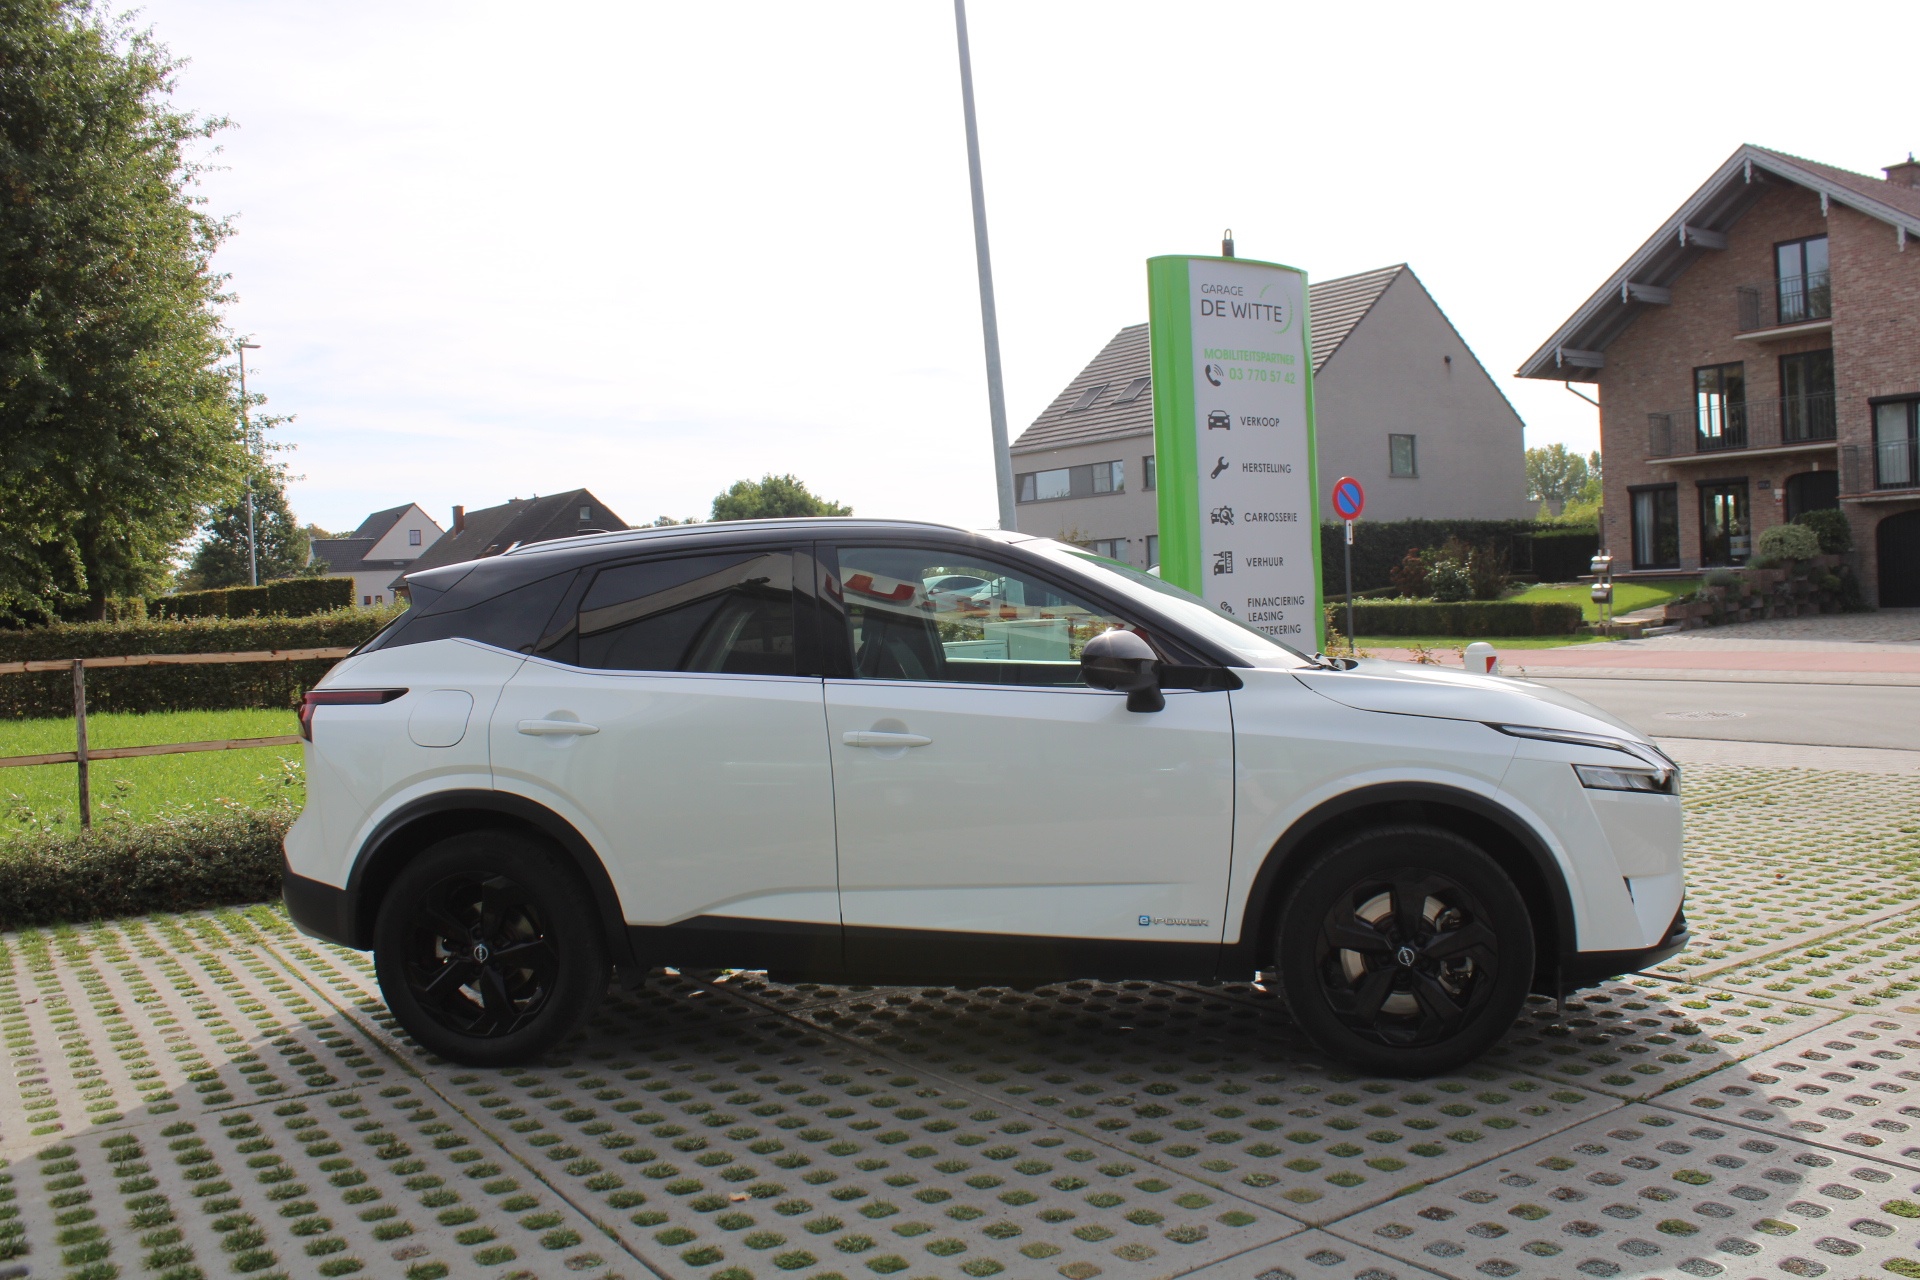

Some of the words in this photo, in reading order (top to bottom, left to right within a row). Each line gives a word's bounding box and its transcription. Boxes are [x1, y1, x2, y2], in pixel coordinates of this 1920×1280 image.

[1201, 283, 1244, 296] GARAGE
[1201, 299, 1226, 317] DE
[1231, 301, 1283, 323] WITTE
[1204, 348, 1295, 365] MOBILITEITSPARTNER
[1229, 368, 1244, 380] 03
[1248, 368, 1267, 382] 770
[1270, 371, 1281, 383] 57
[1284, 372, 1296, 385] 42
[1240, 416, 1280, 427] VERKOOP
[1242, 463, 1292, 474] HERSTELLING
[1244, 512, 1298, 523] CARROSSERIE
[1246, 557, 1284, 567] VERHUUR
[1247, 596, 1305, 608] FINANCIERING
[1248, 611, 1284, 622] LEASING
